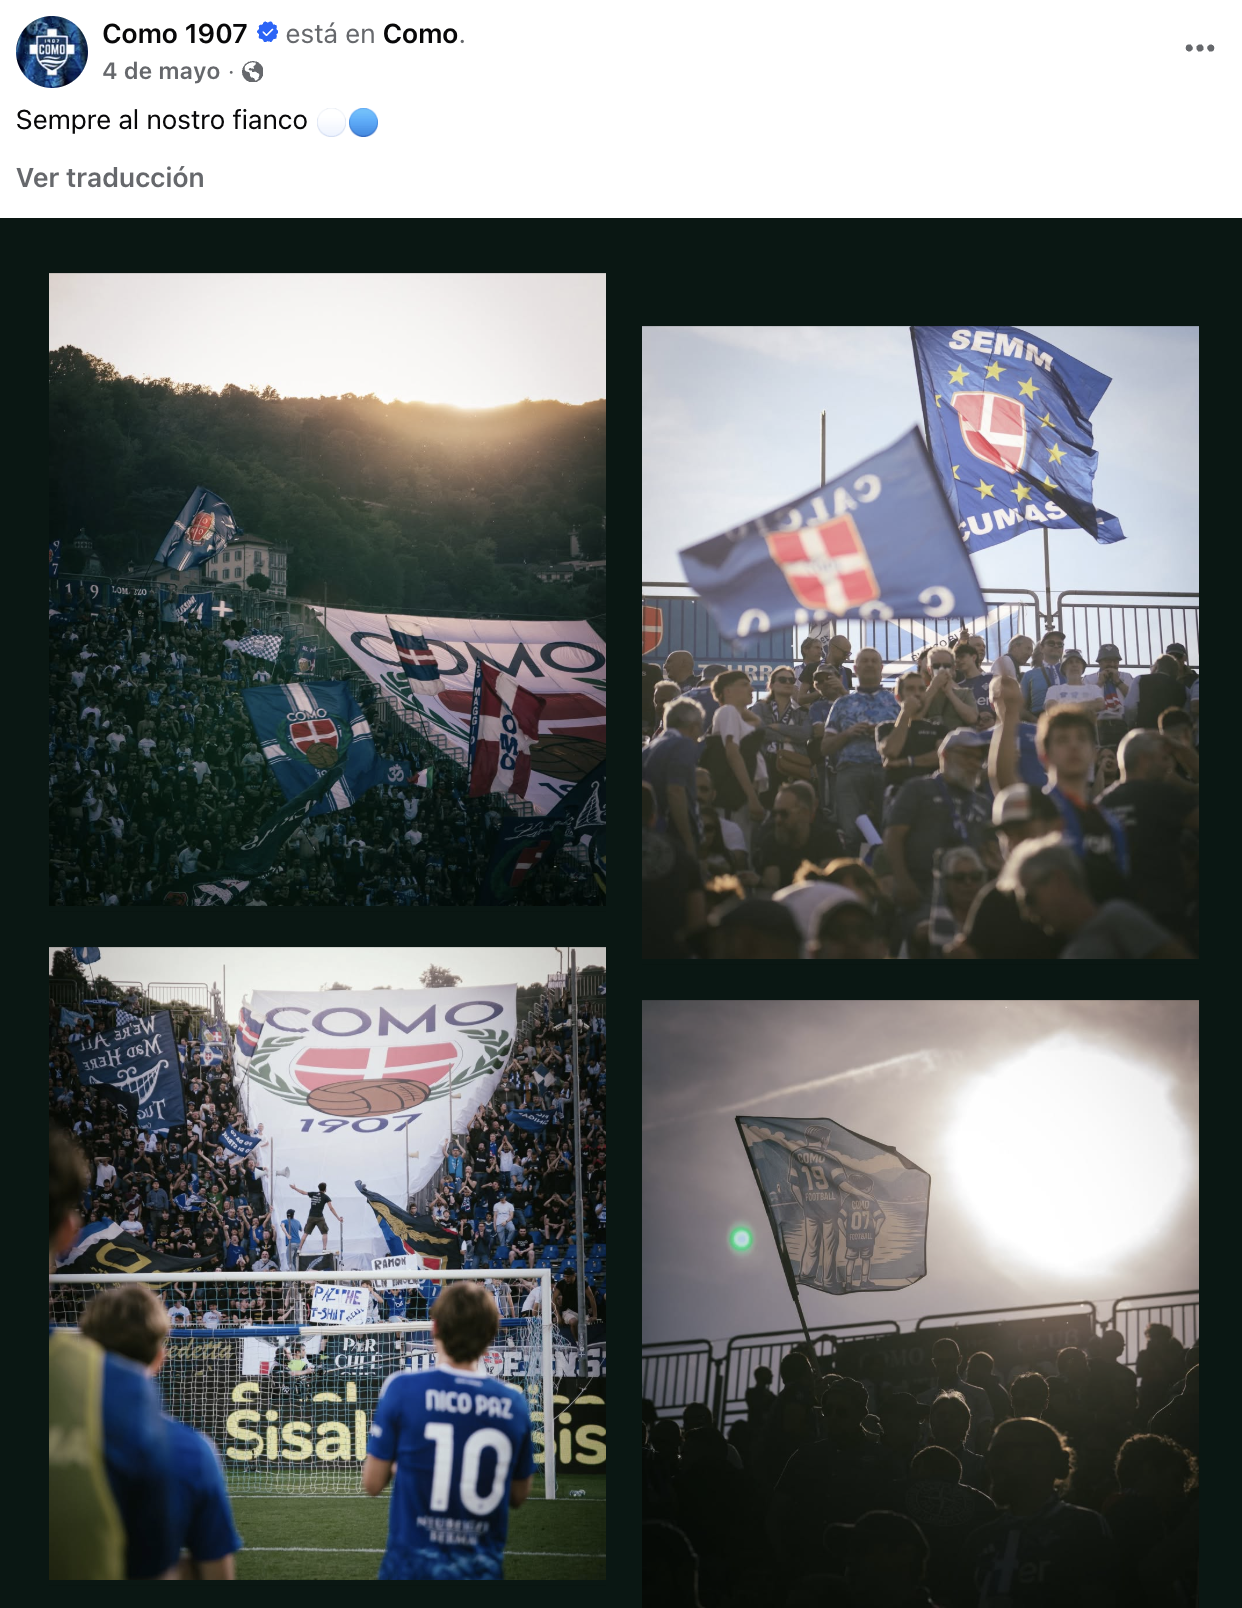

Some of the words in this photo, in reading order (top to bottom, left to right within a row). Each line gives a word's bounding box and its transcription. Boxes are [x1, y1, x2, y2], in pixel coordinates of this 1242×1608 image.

[948, 329, 1054, 372] SEMM
[960, 500, 1067, 542] CUMAS
[351, 631, 606, 678] COMO
[286, 708, 327, 721] COMO
[500, 710, 519, 770] OMO
[266, 1001, 504, 1037] COMO
[300, 1112, 423, 1134] 1907
[798, 1152, 826, 1164] COMO
[802, 1165, 829, 1191] 19
[805, 1190, 836, 1202] FOOTBALL
[851, 1200, 870, 1210] COMO
[851, 1211, 870, 1230] 07
[849, 1232, 873, 1241] FOOTBALL
[425, 1388, 472, 1414] NICO
[475, 1394, 514, 1420] PAZ
[226, 1409, 367, 1461] Sisal
[424, 1421, 513, 1516] 10
